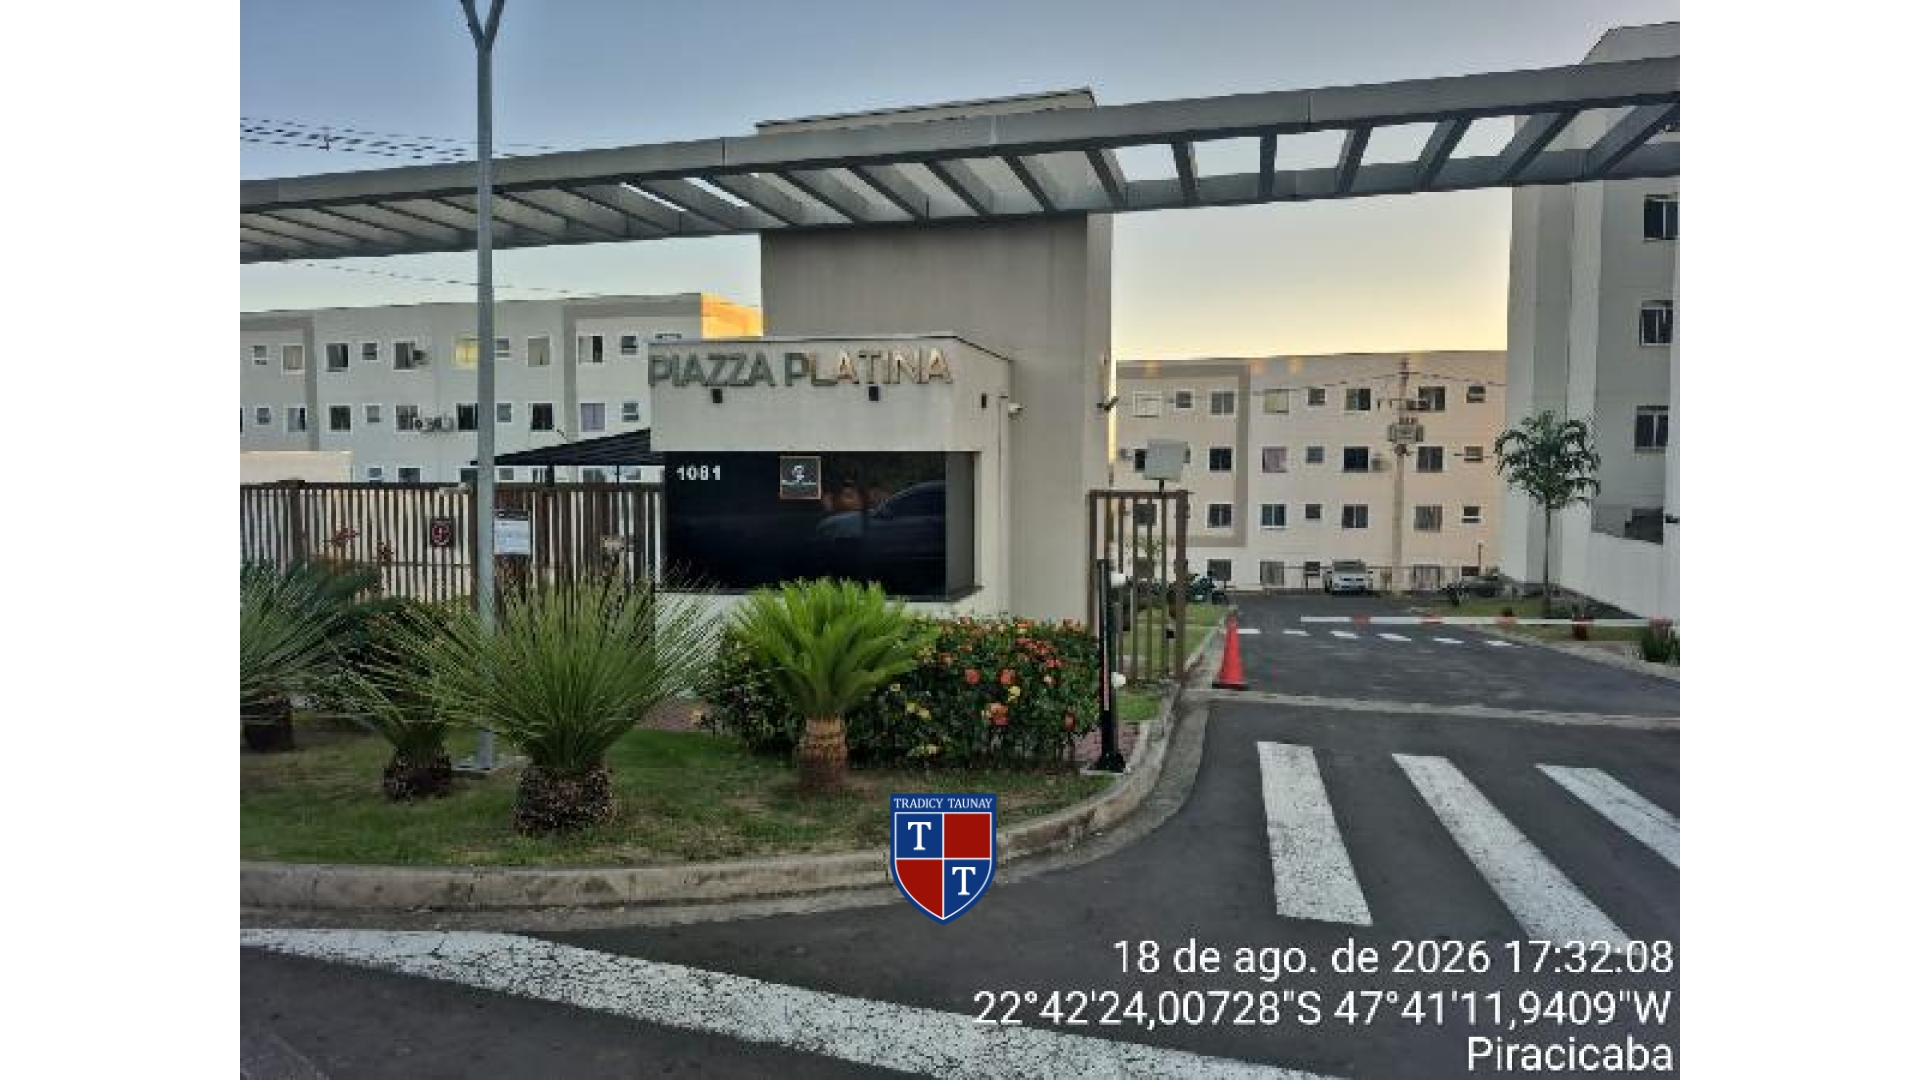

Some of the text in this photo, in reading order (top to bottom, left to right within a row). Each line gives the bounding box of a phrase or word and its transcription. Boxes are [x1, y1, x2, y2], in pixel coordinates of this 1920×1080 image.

[648, 348, 954, 387] PIAZZA PLATINA
[676, 465, 721, 481] 1081
